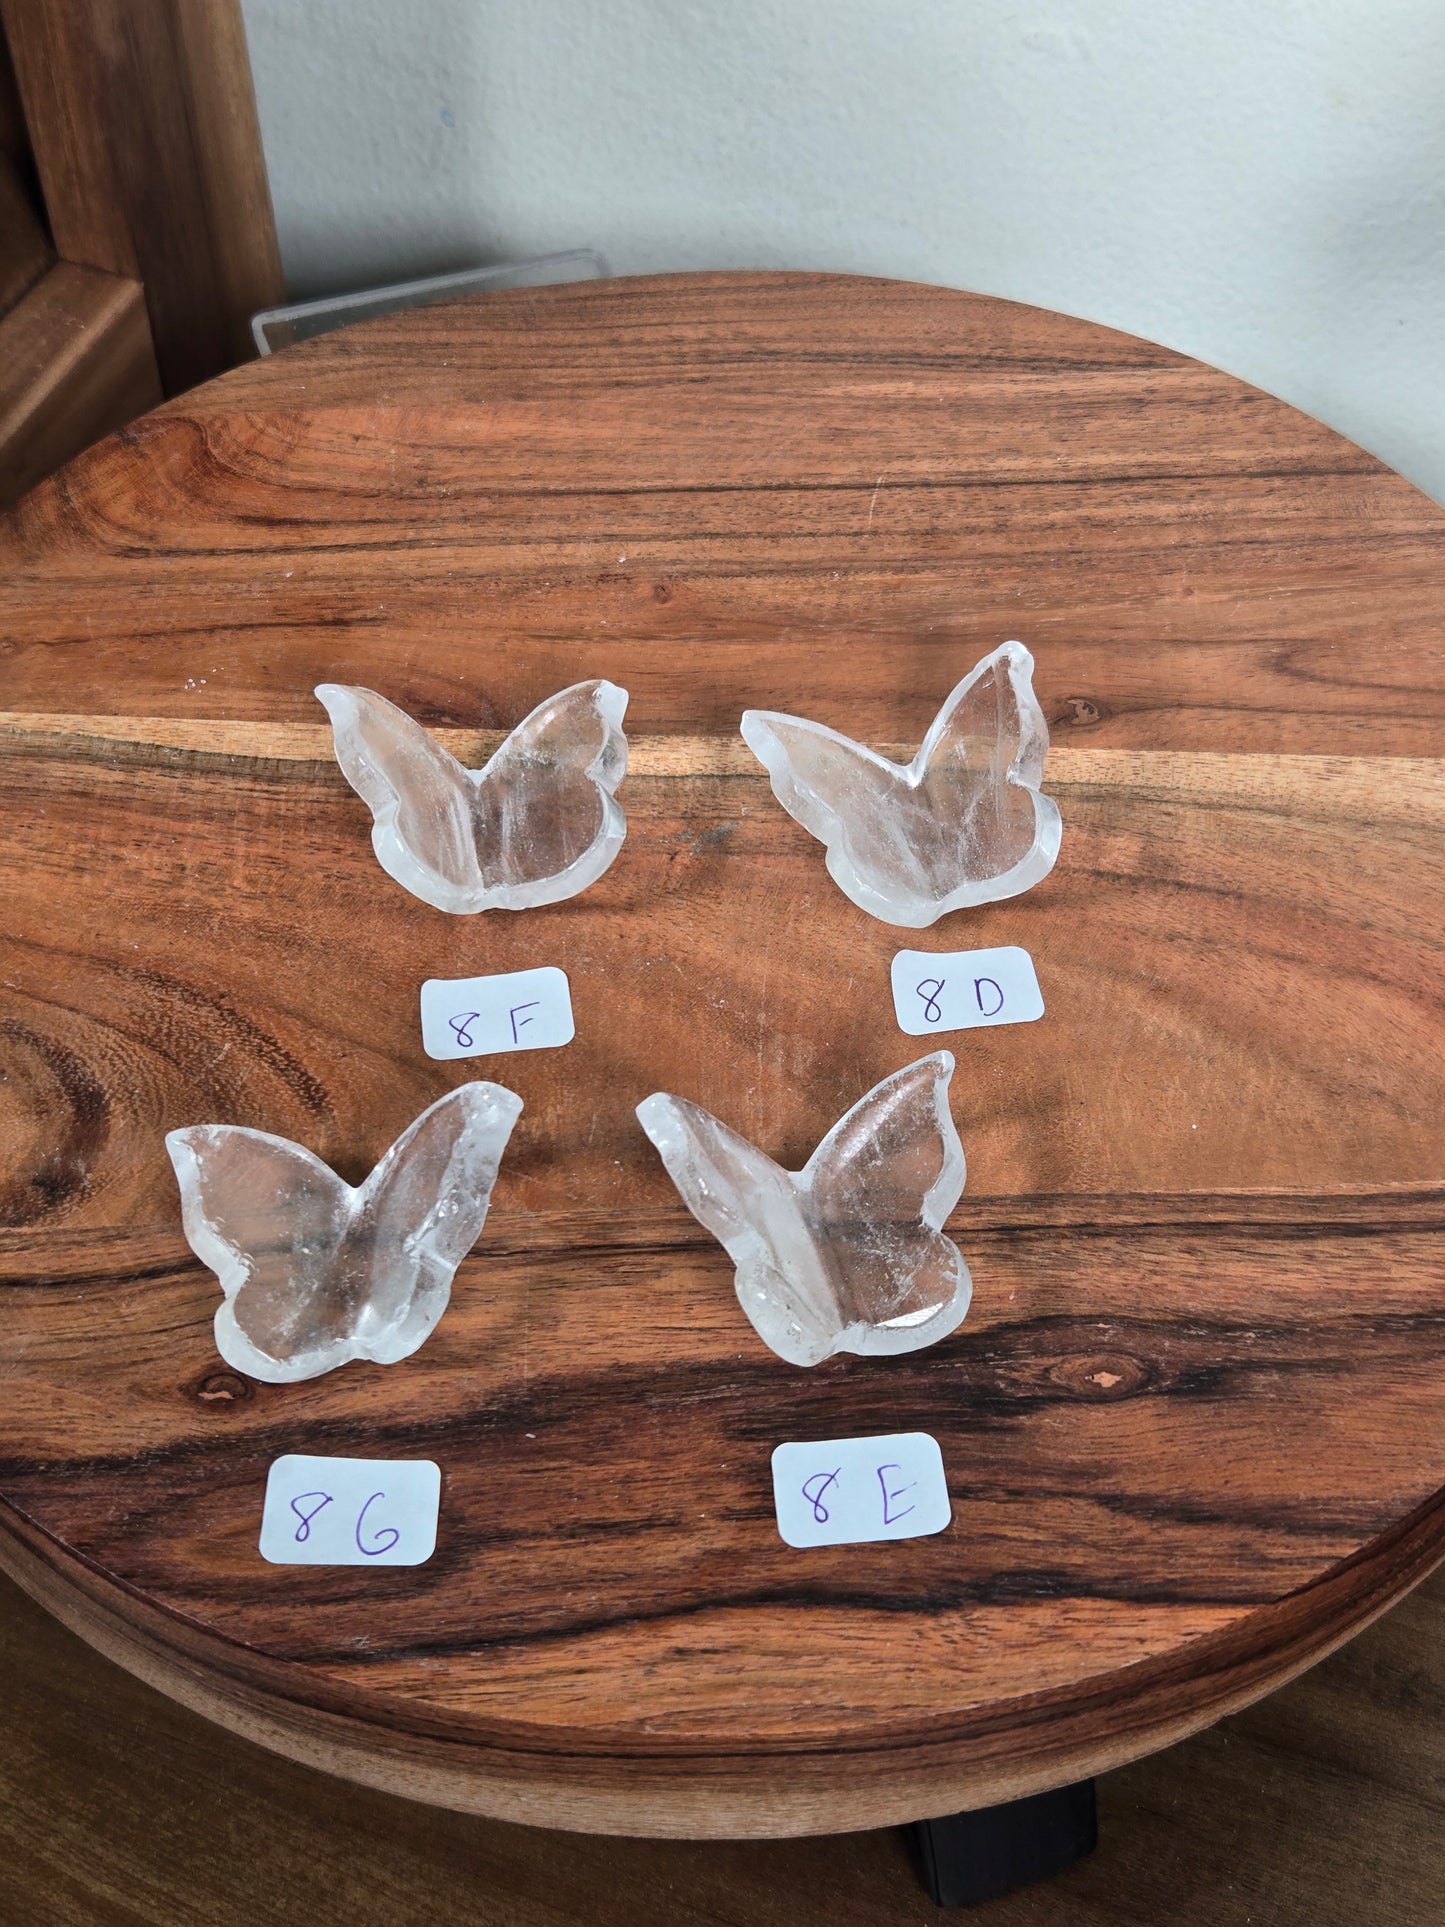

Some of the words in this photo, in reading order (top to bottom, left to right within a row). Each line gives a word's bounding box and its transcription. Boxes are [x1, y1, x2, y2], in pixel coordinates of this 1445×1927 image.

[448, 1011, 481, 1048] 8
[509, 1001, 541, 1045] F
[915, 978, 947, 1023] 8
[973, 977, 1005, 1017] D
[290, 1491, 334, 1543] 8
[801, 1467, 842, 1524] 8
[876, 1464, 917, 1526] E
